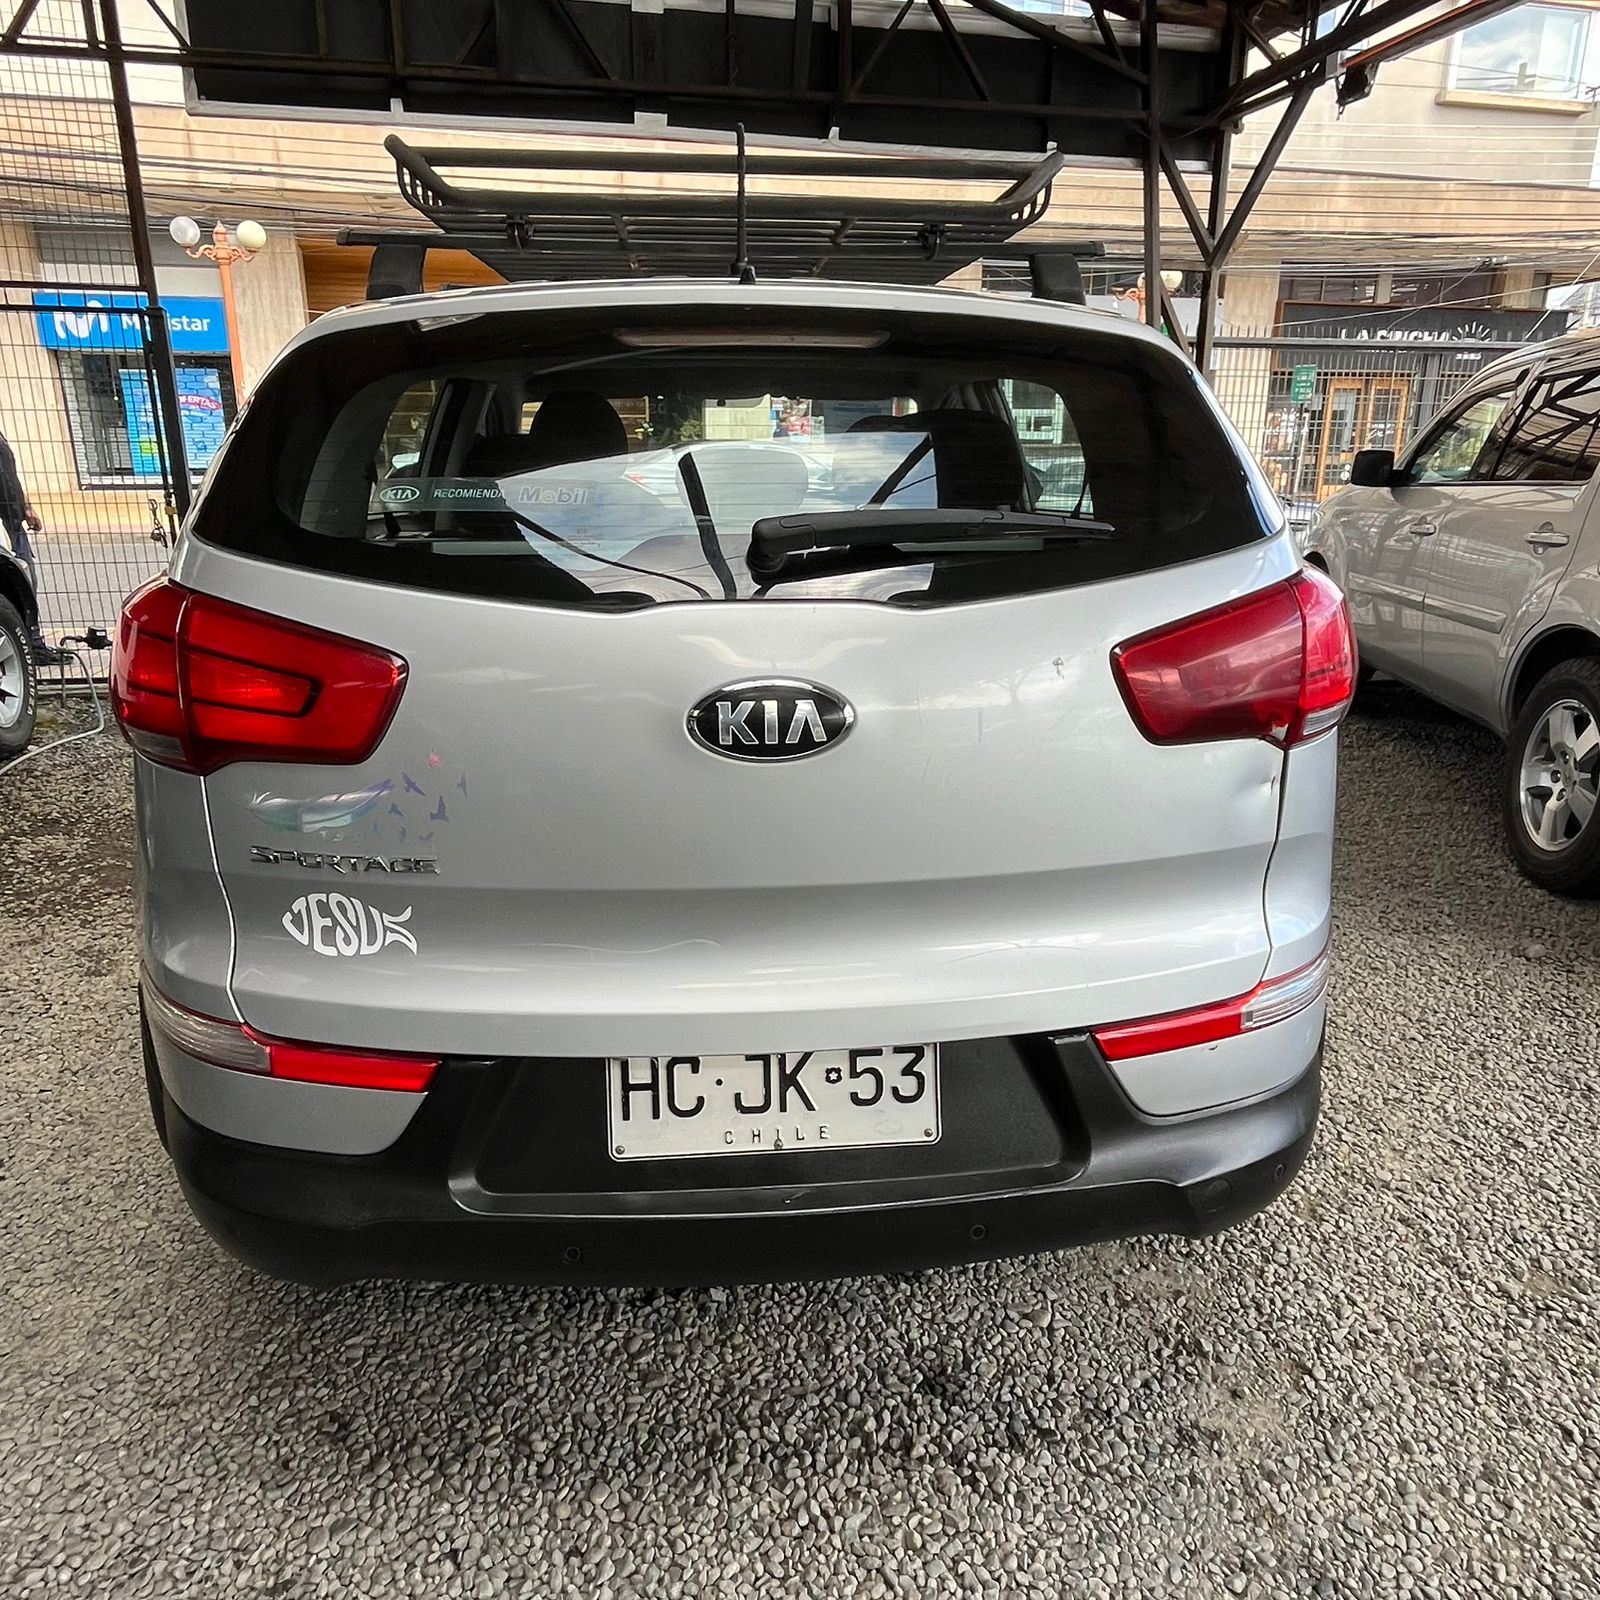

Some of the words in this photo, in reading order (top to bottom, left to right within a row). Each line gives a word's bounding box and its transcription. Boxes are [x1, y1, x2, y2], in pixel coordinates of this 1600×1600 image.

[121, 312, 211, 332] Mistar
[386, 488, 414, 501] KIA
[518, 486, 590, 505] Mobil
[716, 699, 828, 745] KIA
[250, 845, 441, 874] SPORTAGE
[281, 892, 418, 957] JESUS
[724, 1125, 831, 1145] CHILE
